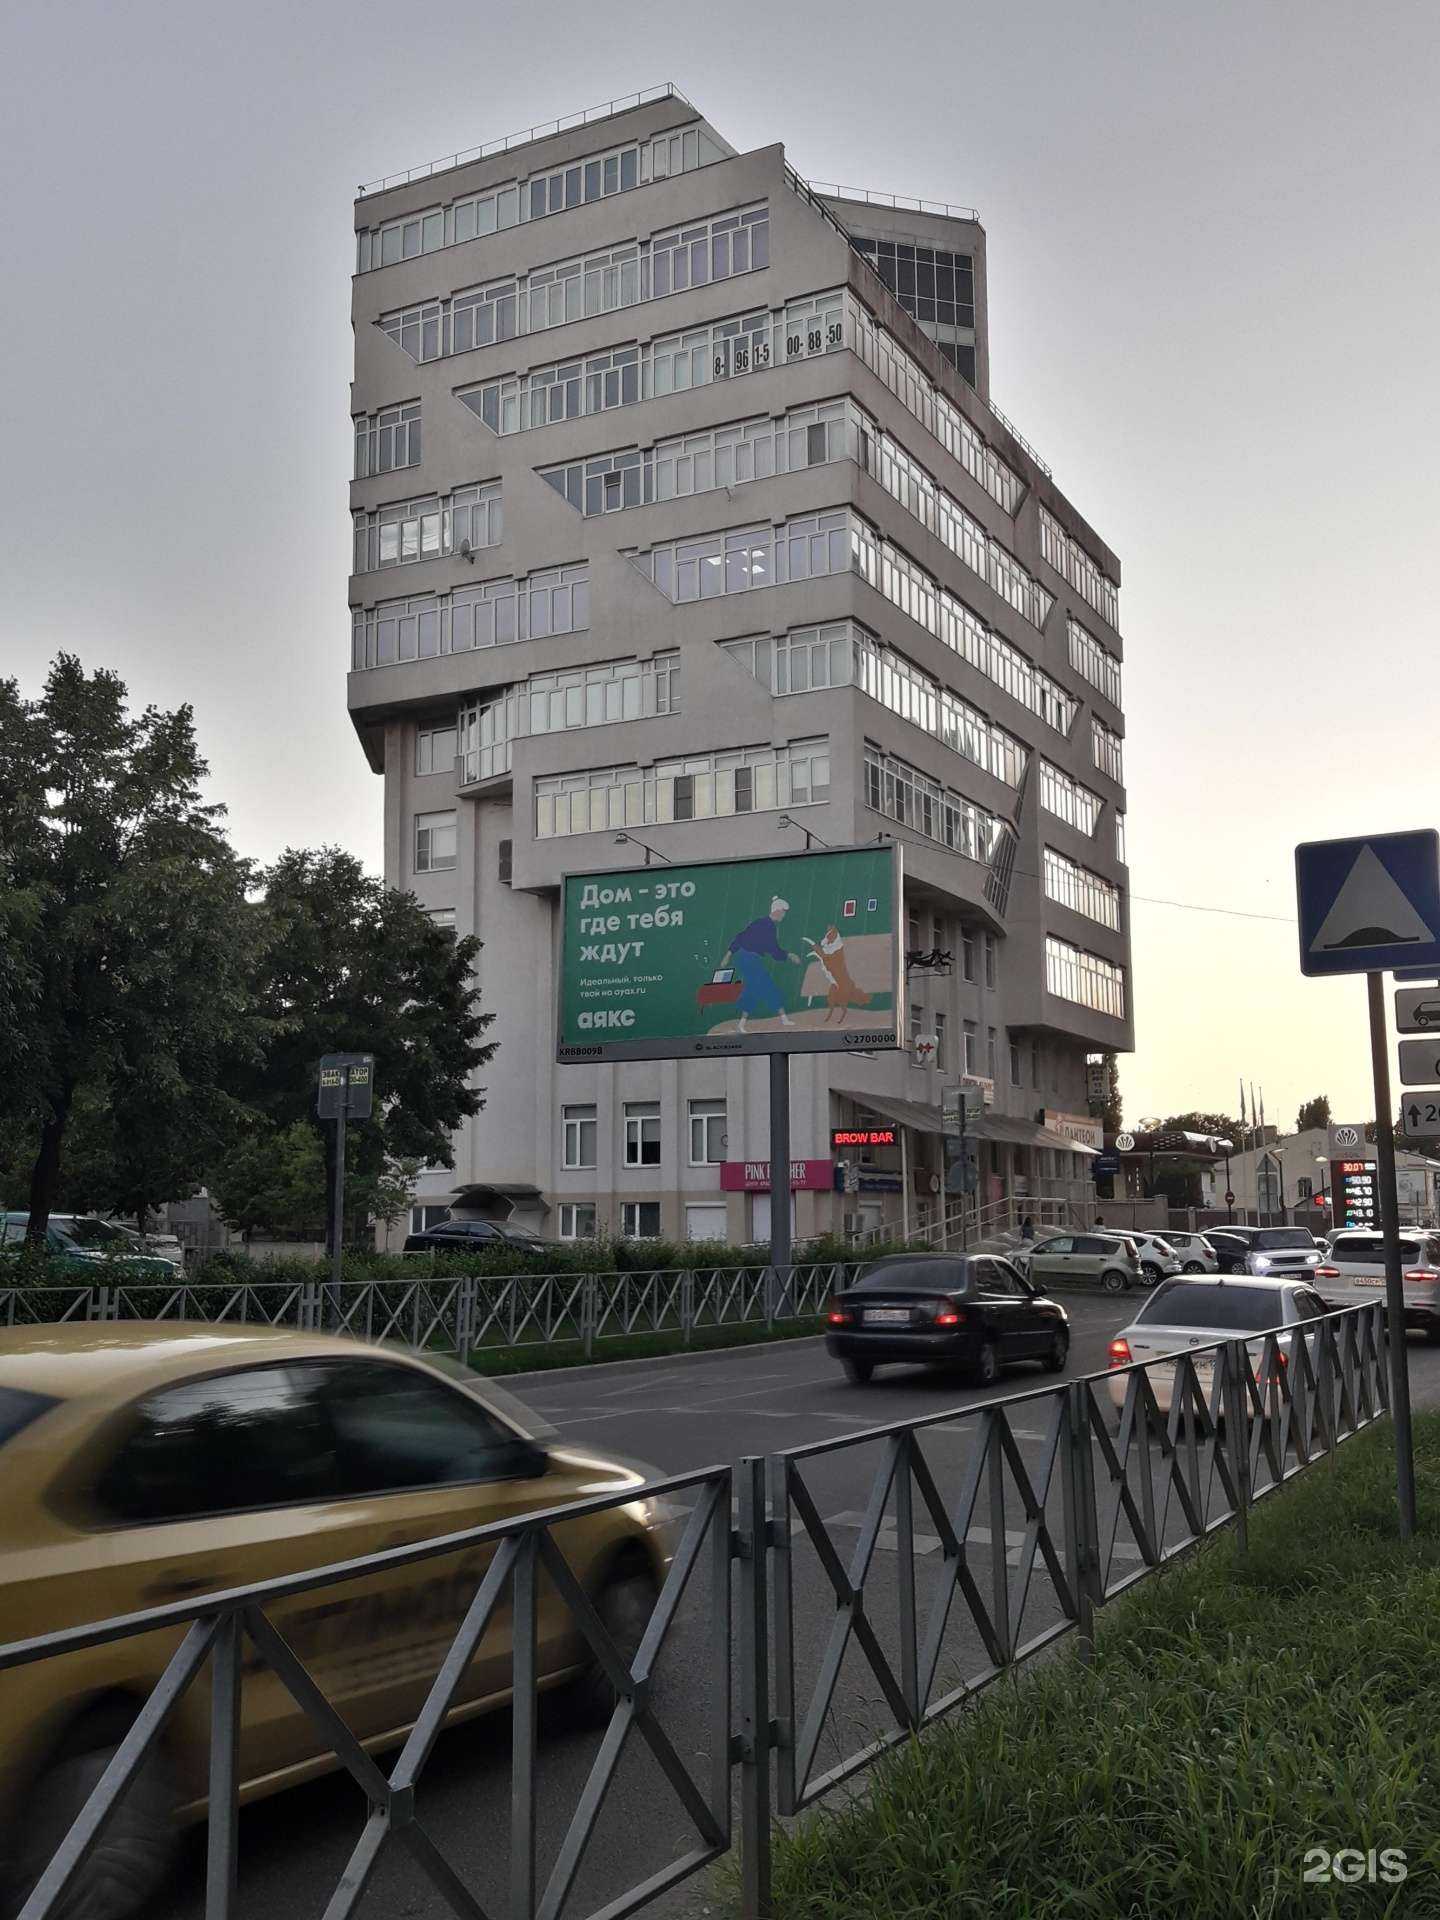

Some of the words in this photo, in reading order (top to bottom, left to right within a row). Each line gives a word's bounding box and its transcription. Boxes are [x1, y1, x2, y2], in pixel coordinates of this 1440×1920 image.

[580, 884, 633, 910] Дом
[655, 881, 696, 900] это
[580, 915, 621, 936] где
[627, 904, 684, 930] тебя
[580, 941, 645, 964] ждут
[633, 974, 663, 983] только
[601, 988, 612, 996] на
[577, 1009, 636, 1029] аякс
[854, 1034, 896, 1044] 2700000
[1425, 1104, 1440, 1121] 2
[835, 1132, 869, 1144] BROW
[870, 1132, 894, 1143] BAR
[745, 1163, 765, 1181] PINK
